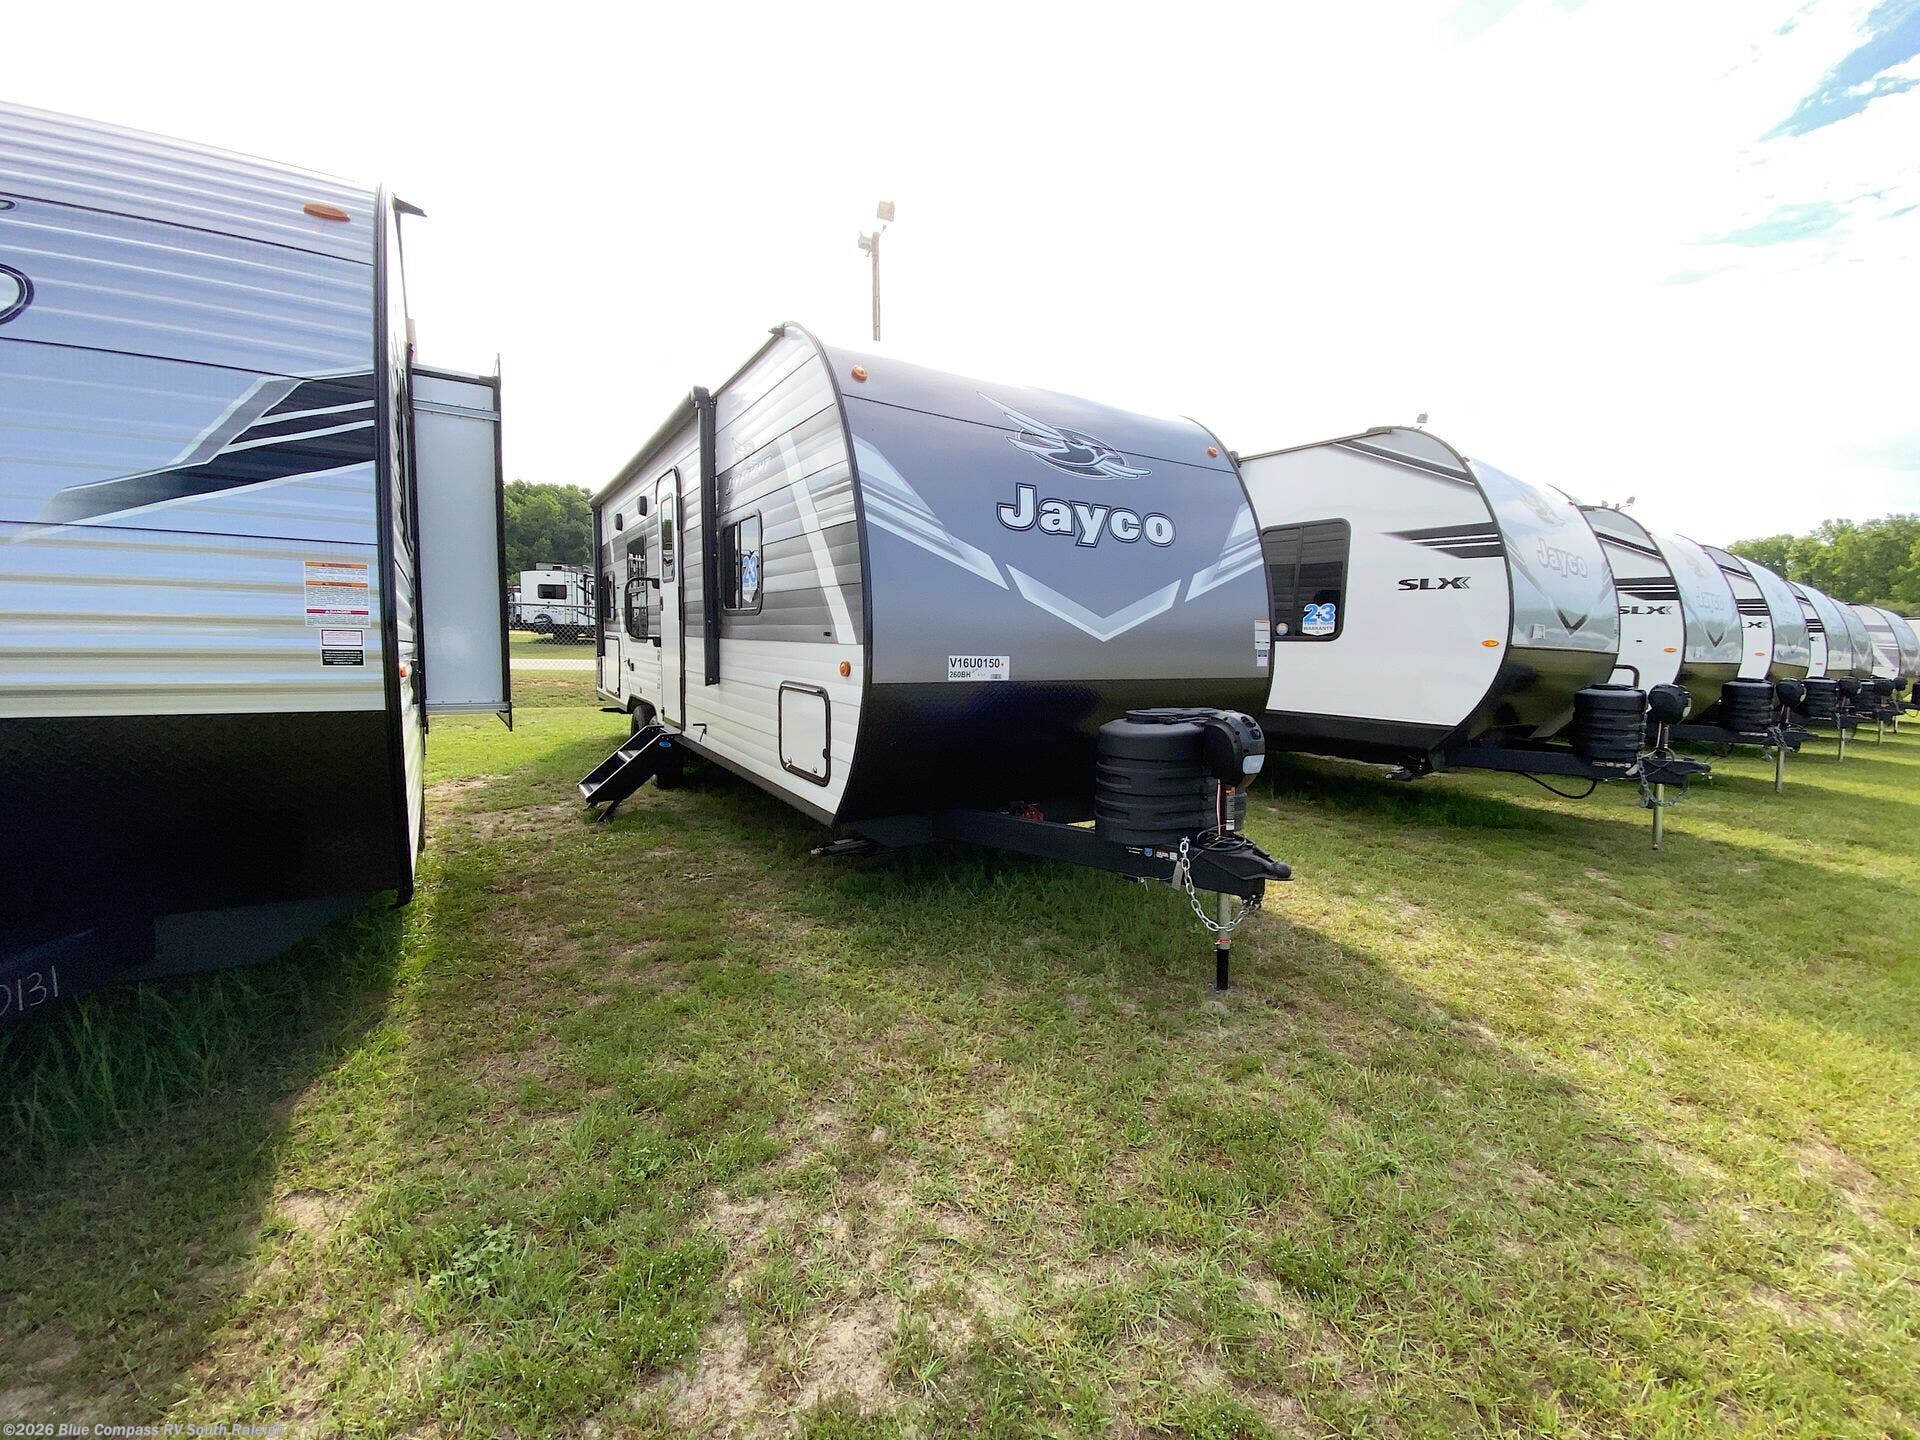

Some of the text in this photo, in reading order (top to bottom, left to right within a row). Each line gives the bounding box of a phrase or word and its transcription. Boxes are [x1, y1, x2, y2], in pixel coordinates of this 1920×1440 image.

[997, 482, 1177, 548] Jayco
[1536, 537, 1589, 578] Jayco
[1398, 576, 1467, 591] SLX
